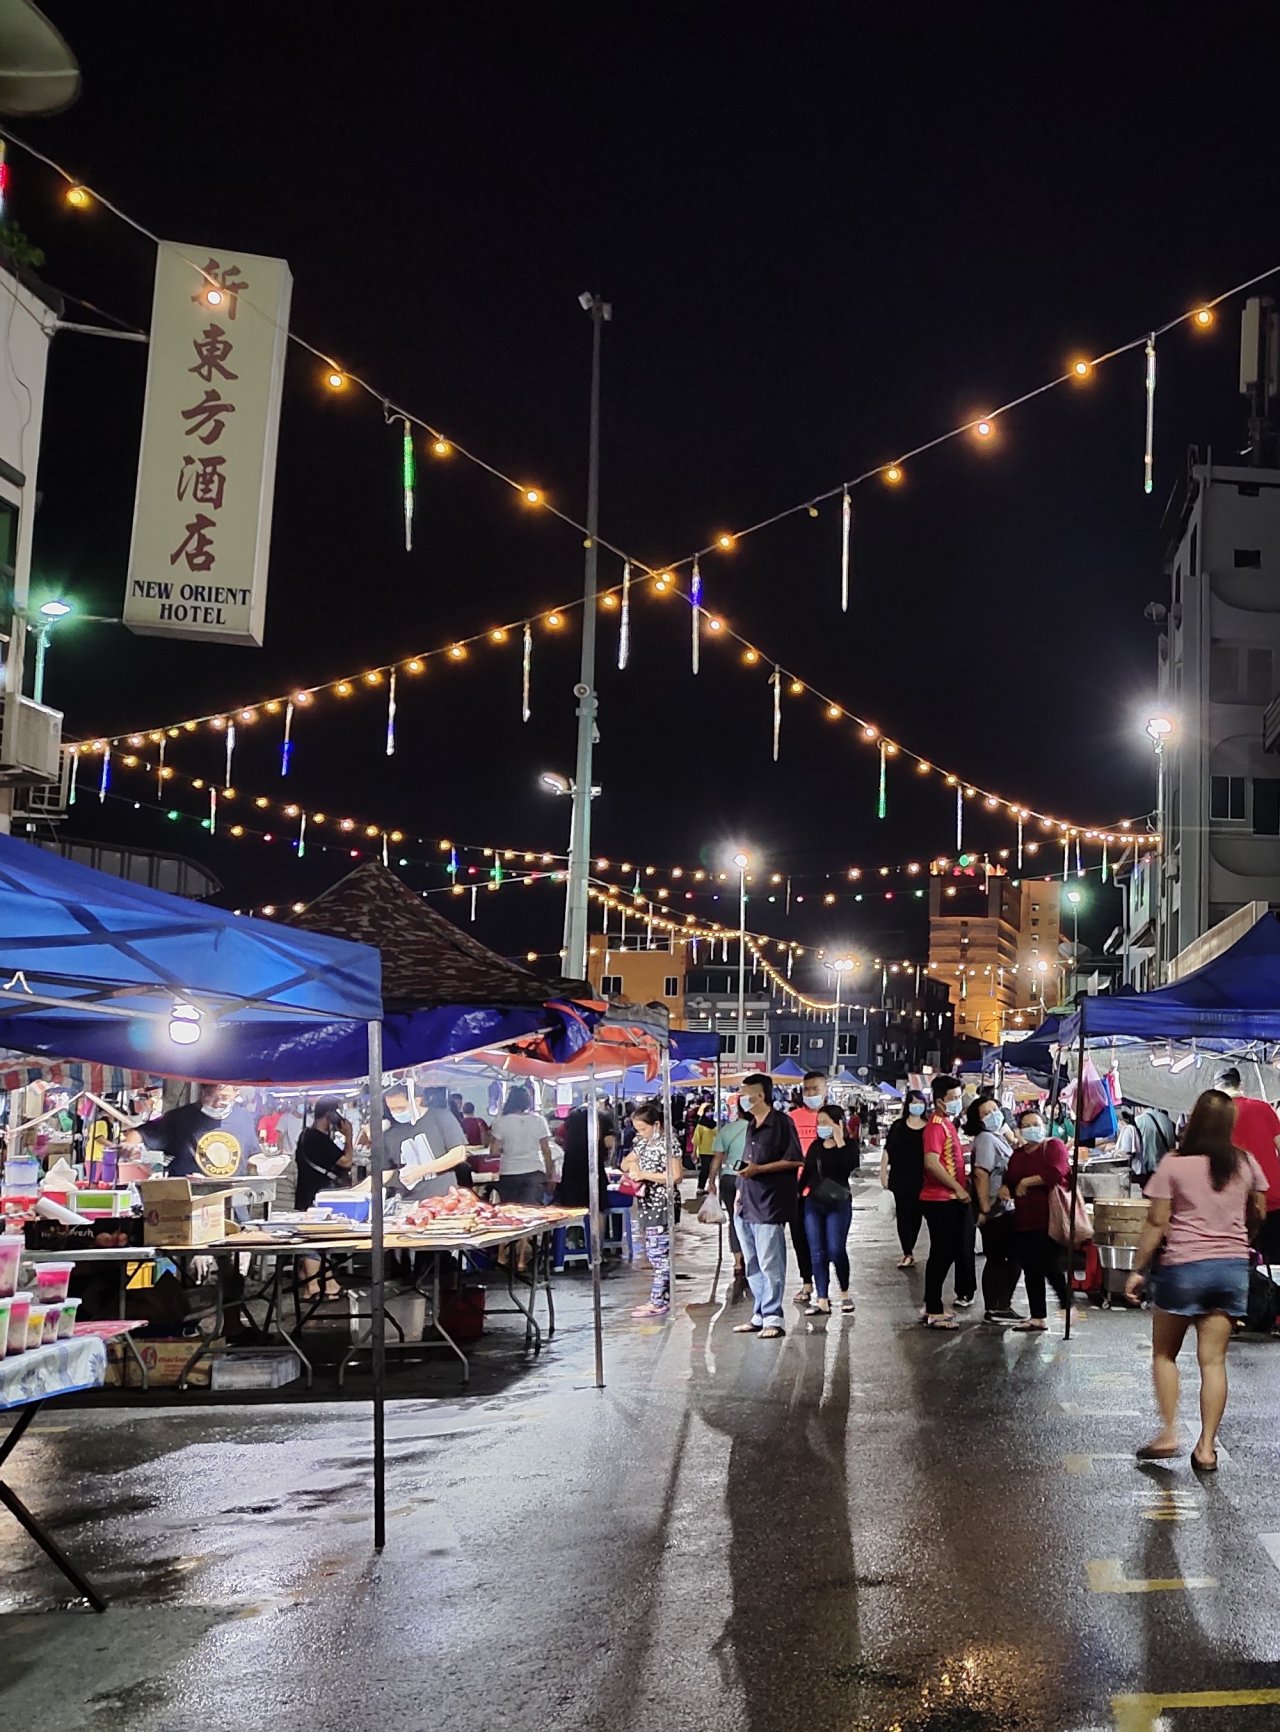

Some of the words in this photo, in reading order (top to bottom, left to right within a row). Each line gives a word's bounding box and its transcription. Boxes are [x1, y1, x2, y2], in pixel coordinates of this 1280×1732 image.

[132, 580, 174, 600] NEW
[180, 584, 251, 605] ORIENT
[160, 603, 226, 625] HOTEL
